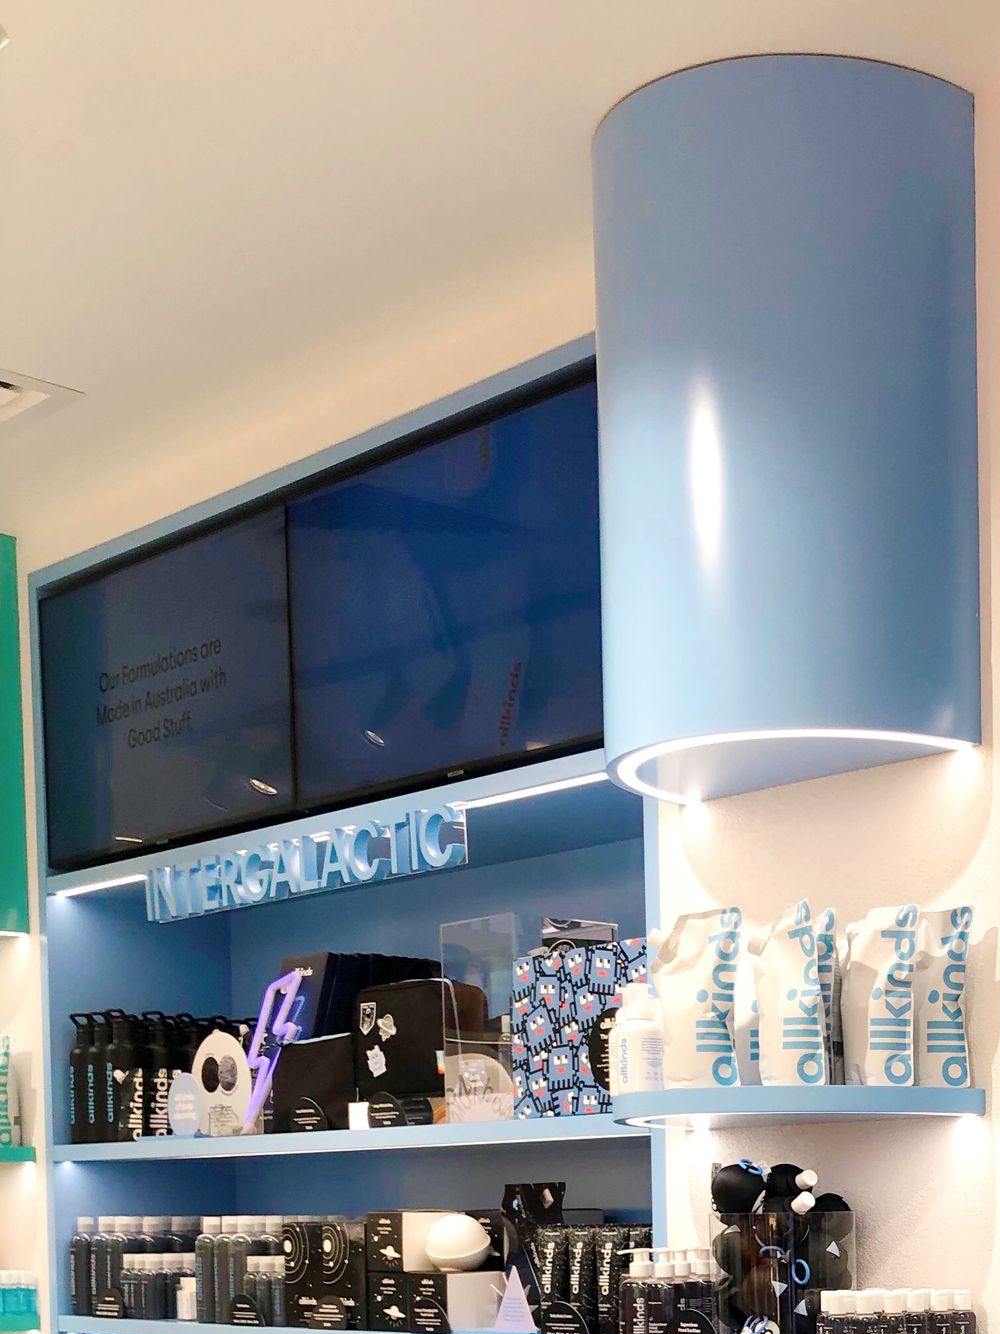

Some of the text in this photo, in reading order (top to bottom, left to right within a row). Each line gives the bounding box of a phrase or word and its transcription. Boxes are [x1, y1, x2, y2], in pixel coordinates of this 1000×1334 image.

[121, 646, 198, 685] Formulations
[200, 639, 222, 660] are
[96, 702, 130, 727] Made
[144, 678, 198, 711] Australia
[200, 666, 227, 693] with
[127, 719, 161, 748] Good
[145, 804, 460, 922] INTERGALACTIC
[695, 906, 742, 1087] allkinds
[782, 898, 824, 1084] allkinds
[869, 904, 919, 1085] allkinds
[926, 905, 974, 1087] allkinds
[129, 1066, 144, 1141] allkinds
[540, 1241, 556, 1295] allkinds
[570, 1241, 584, 1295] allkinds
[599, 1241, 613, 1296] allkinds
